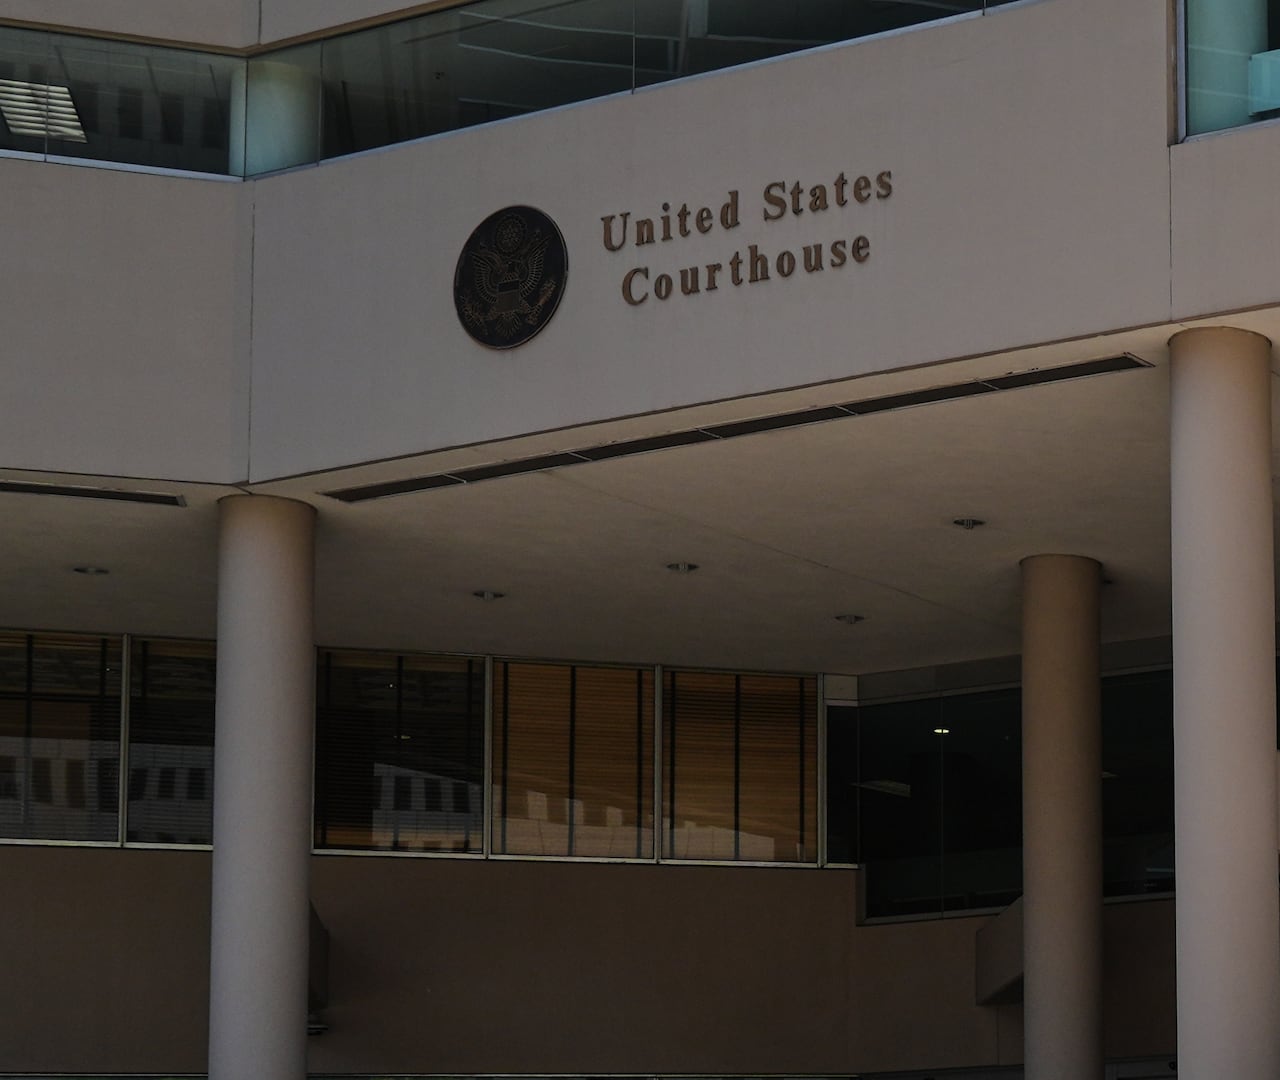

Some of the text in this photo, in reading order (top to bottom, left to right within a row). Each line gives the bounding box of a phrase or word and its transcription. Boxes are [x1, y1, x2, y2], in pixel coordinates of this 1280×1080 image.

[600, 170, 893, 252] United States
[621, 235, 870, 305] Courthouse
